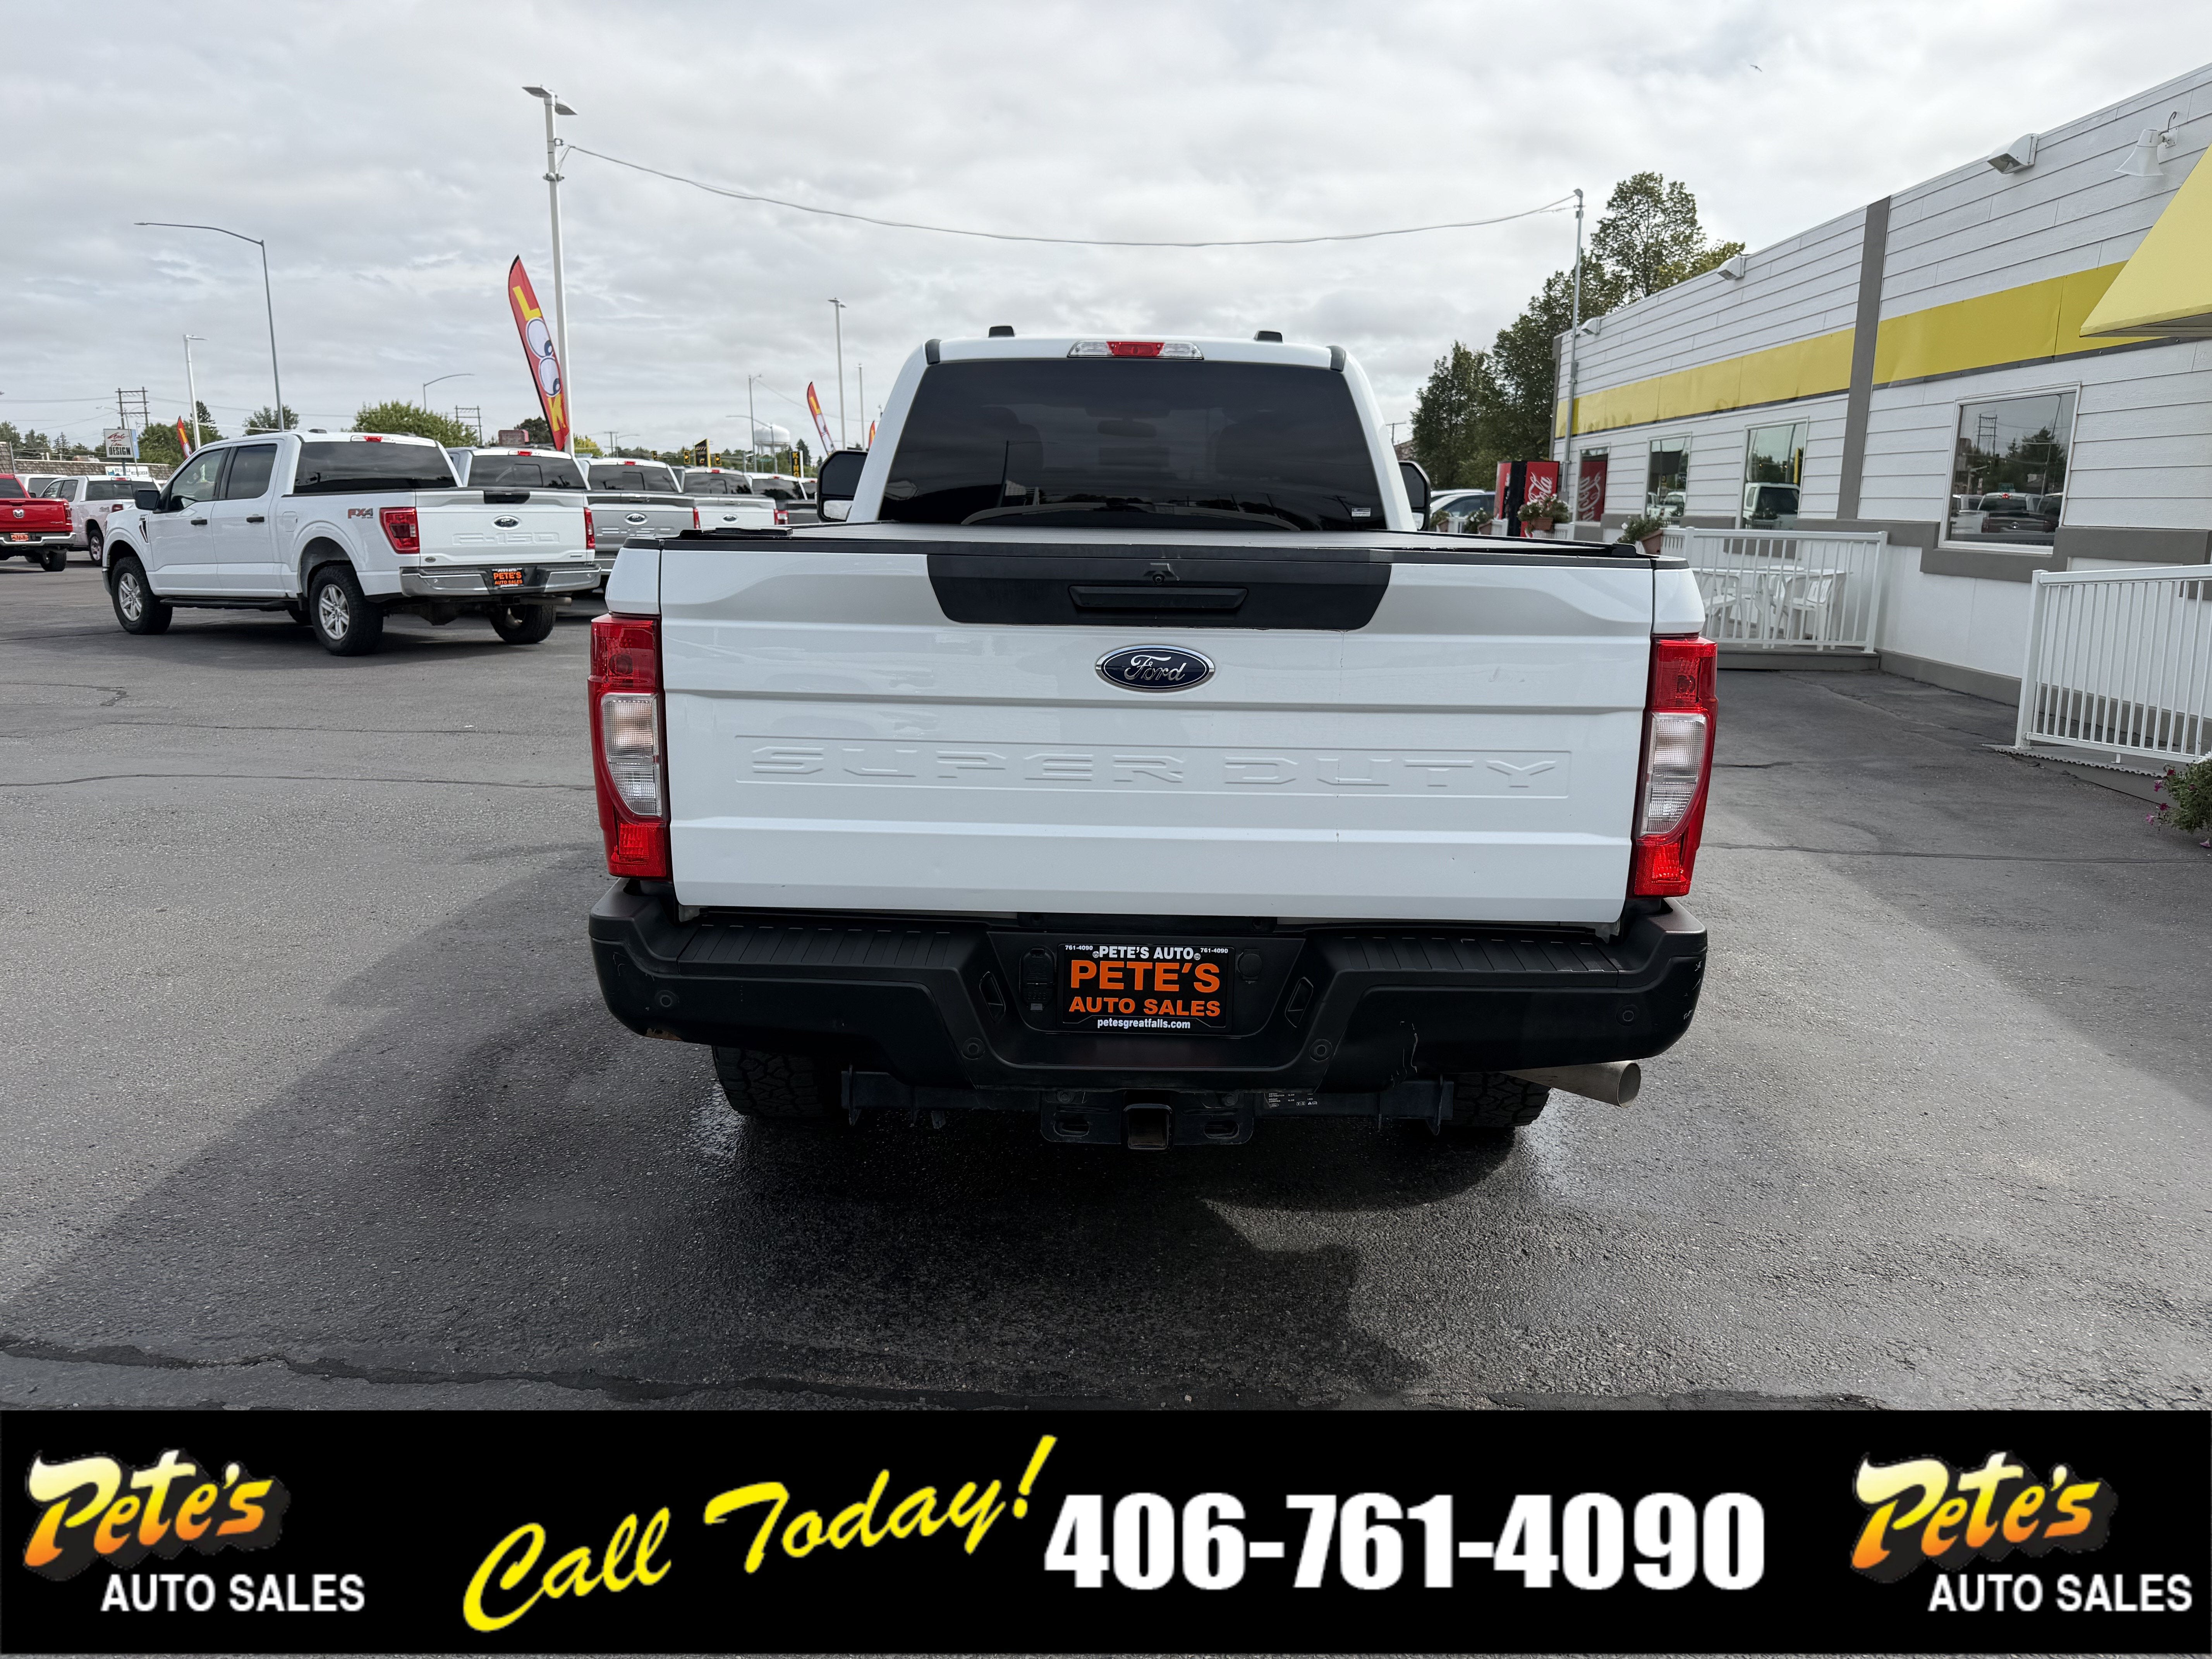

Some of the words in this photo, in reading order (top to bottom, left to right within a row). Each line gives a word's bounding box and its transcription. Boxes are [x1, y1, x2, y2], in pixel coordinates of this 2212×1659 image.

[109, 447, 131, 455] DESIGN
[347, 508, 373, 519] FX4
[452, 532, 560, 546] F-150
[493, 572, 522, 580] PETE'S
[1124, 655, 1187, 681] Ford
[752, 746, 1183, 783] SUPER
[1224, 756, 1556, 788] DUTY
[1099, 946, 1149, 959] PETE'S
[1154, 947, 1194, 960] AUTO
[1071, 960, 1220, 993] PETE'S
[1069, 996, 1135, 1014] AUTO
[1143, 999, 1221, 1017] SALES
[1097, 1018, 1191, 1029] petesgreatfalls.com
